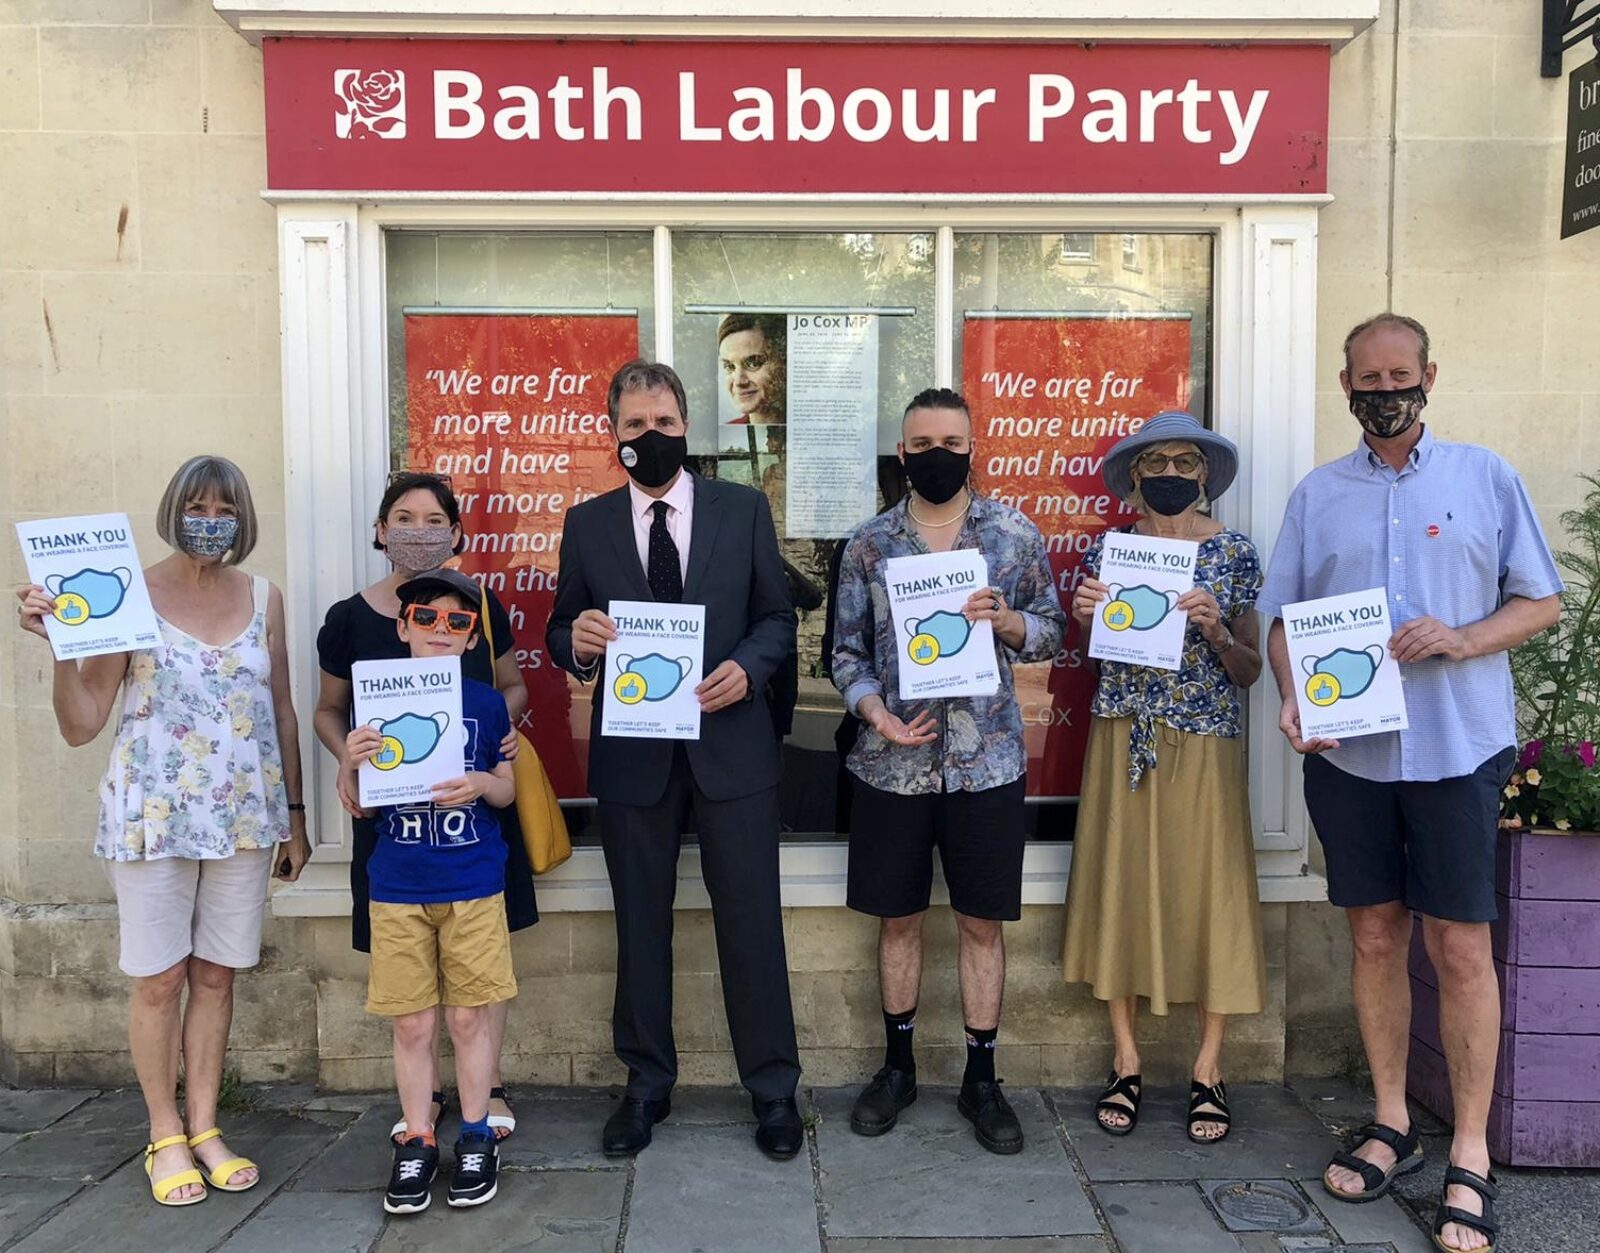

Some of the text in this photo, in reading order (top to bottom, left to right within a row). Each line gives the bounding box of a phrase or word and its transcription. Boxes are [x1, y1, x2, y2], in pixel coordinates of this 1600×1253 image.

[433, 66, 1270, 165] Bath Labour Party
[792, 315, 868, 330] Jo Cox MP
[490, 374, 539, 395] are
[544, 367, 592, 402] far
[1045, 377, 1091, 398] are
[1095, 371, 1143, 405] far
[433, 414, 512, 435] more
[987, 411, 1143, 437] more unite
[435, 448, 570, 475] and have
[987, 451, 1102, 476] and hav
[486, 492, 564, 514] more
[1034, 494, 1110, 515] more
[28, 529, 127, 550] THANK YOU
[46, 549, 76, 557] WEARING
[1110, 548, 1191, 568] THANK YOU
[893, 570, 975, 596] THANK YOU
[907, 593, 931, 601] WEARING
[951, 584, 977, 593] COVERING
[614, 617, 698, 632] THANK YOU
[1290, 605, 1382, 632] THANK YOU
[1305, 629, 1332, 638] WEARING
[1354, 620, 1384, 629] COVERING
[360, 673, 451, 693] THANK YOU
[374, 692, 401, 700] WEARING
[423, 687, 452, 695] COVERING
[1020, 702, 1072, 726] Cox
